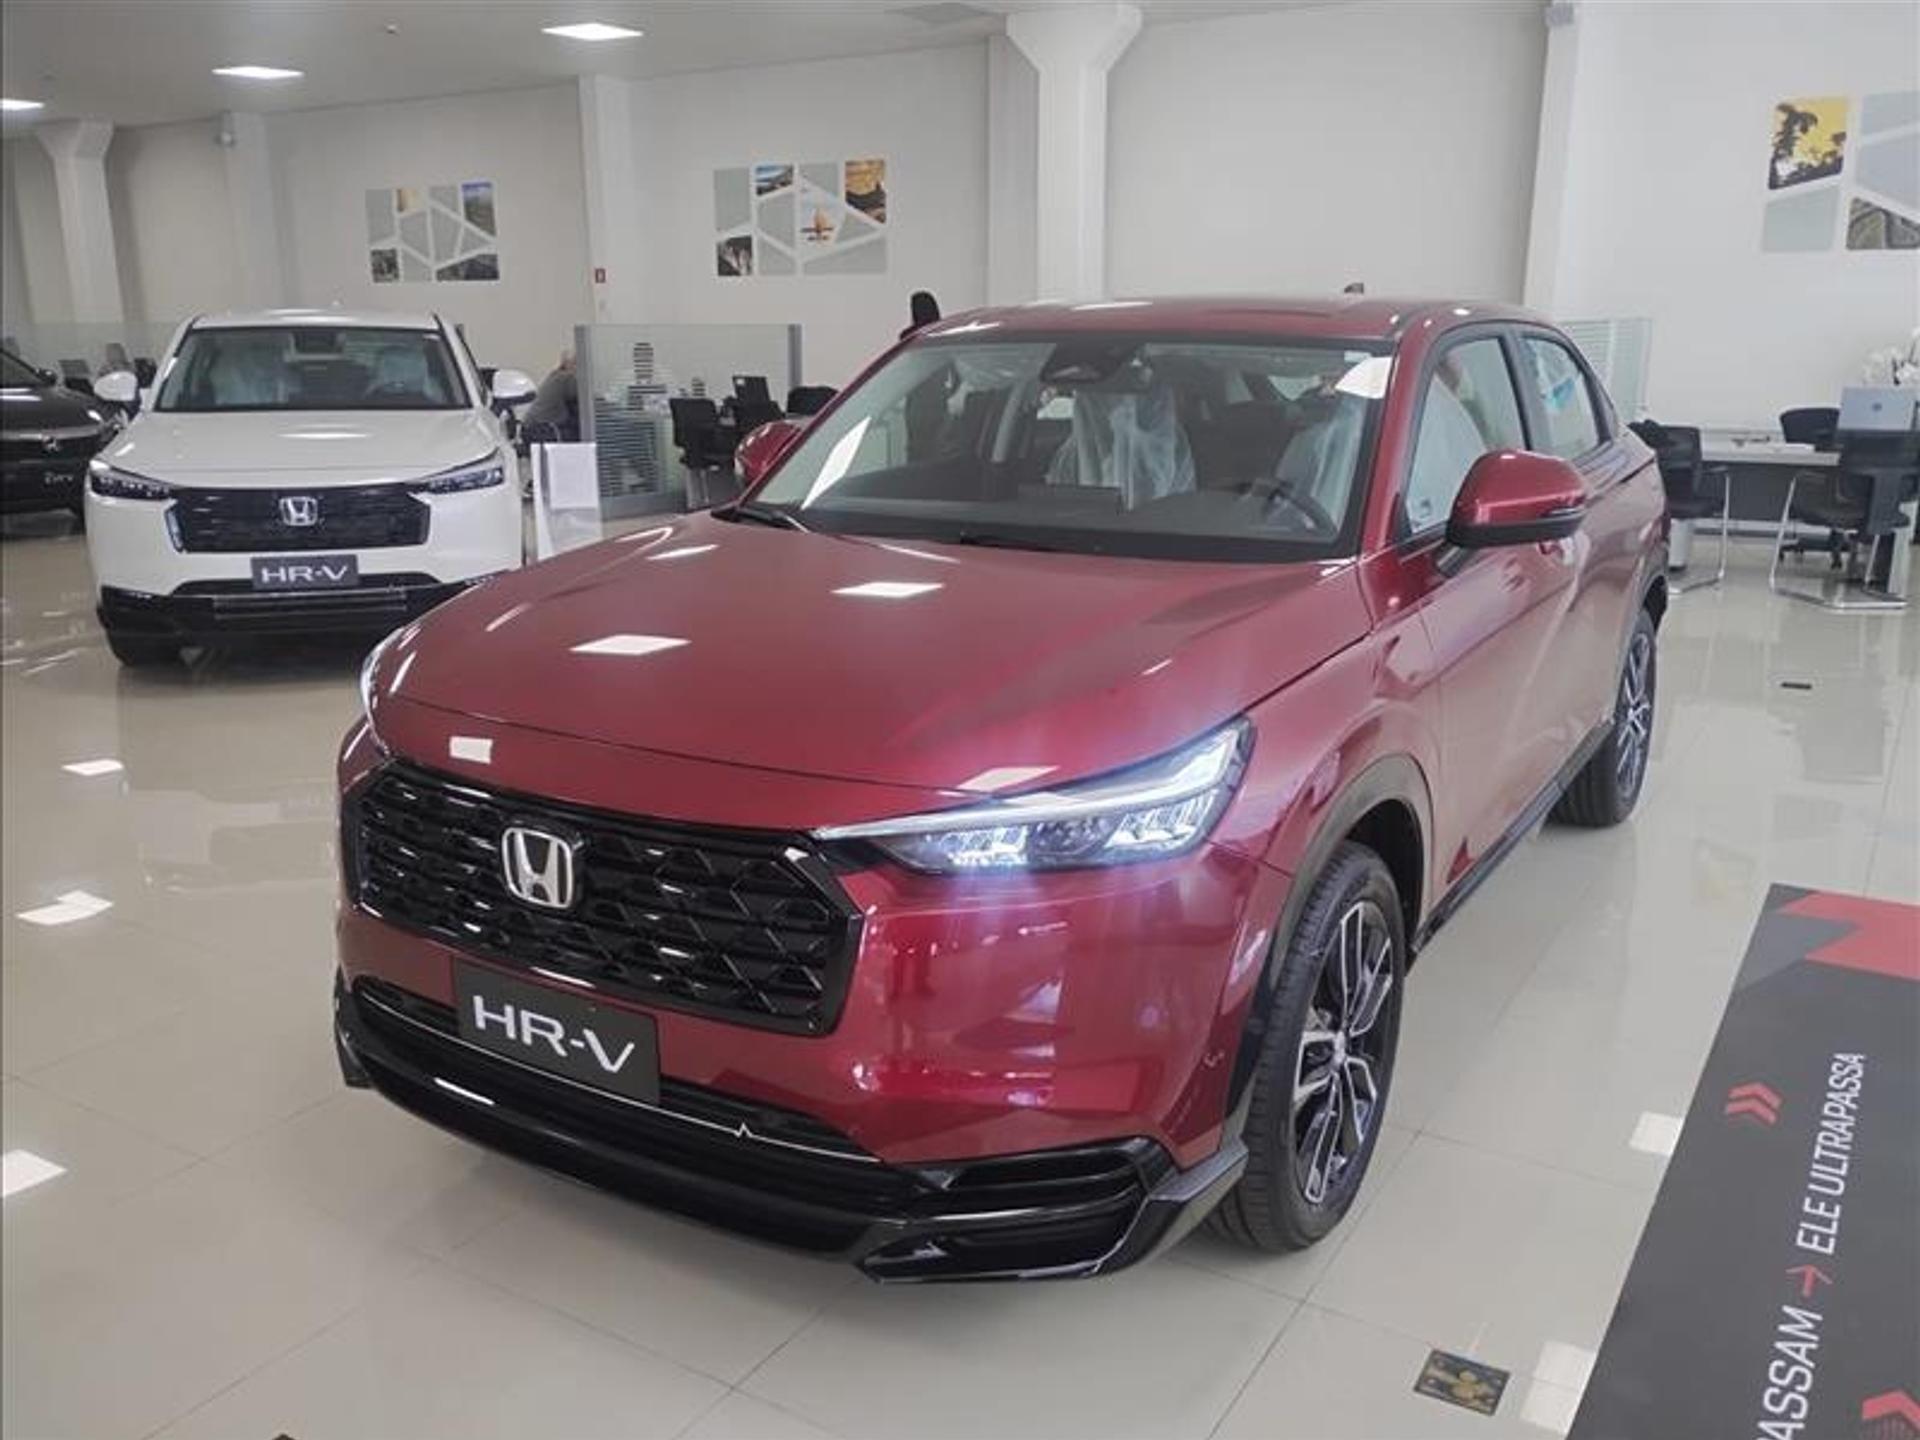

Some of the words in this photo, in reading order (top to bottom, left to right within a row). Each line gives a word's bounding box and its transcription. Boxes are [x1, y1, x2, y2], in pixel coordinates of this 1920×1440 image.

[261, 565, 348, 583] HR-V
[473, 995, 635, 1073] HR-V
[1807, 1053, 1866, 1196] ULTRAPASSA
[1796, 1197, 1841, 1255] ELE
[1756, 1305, 1823, 1440] ASSAM
